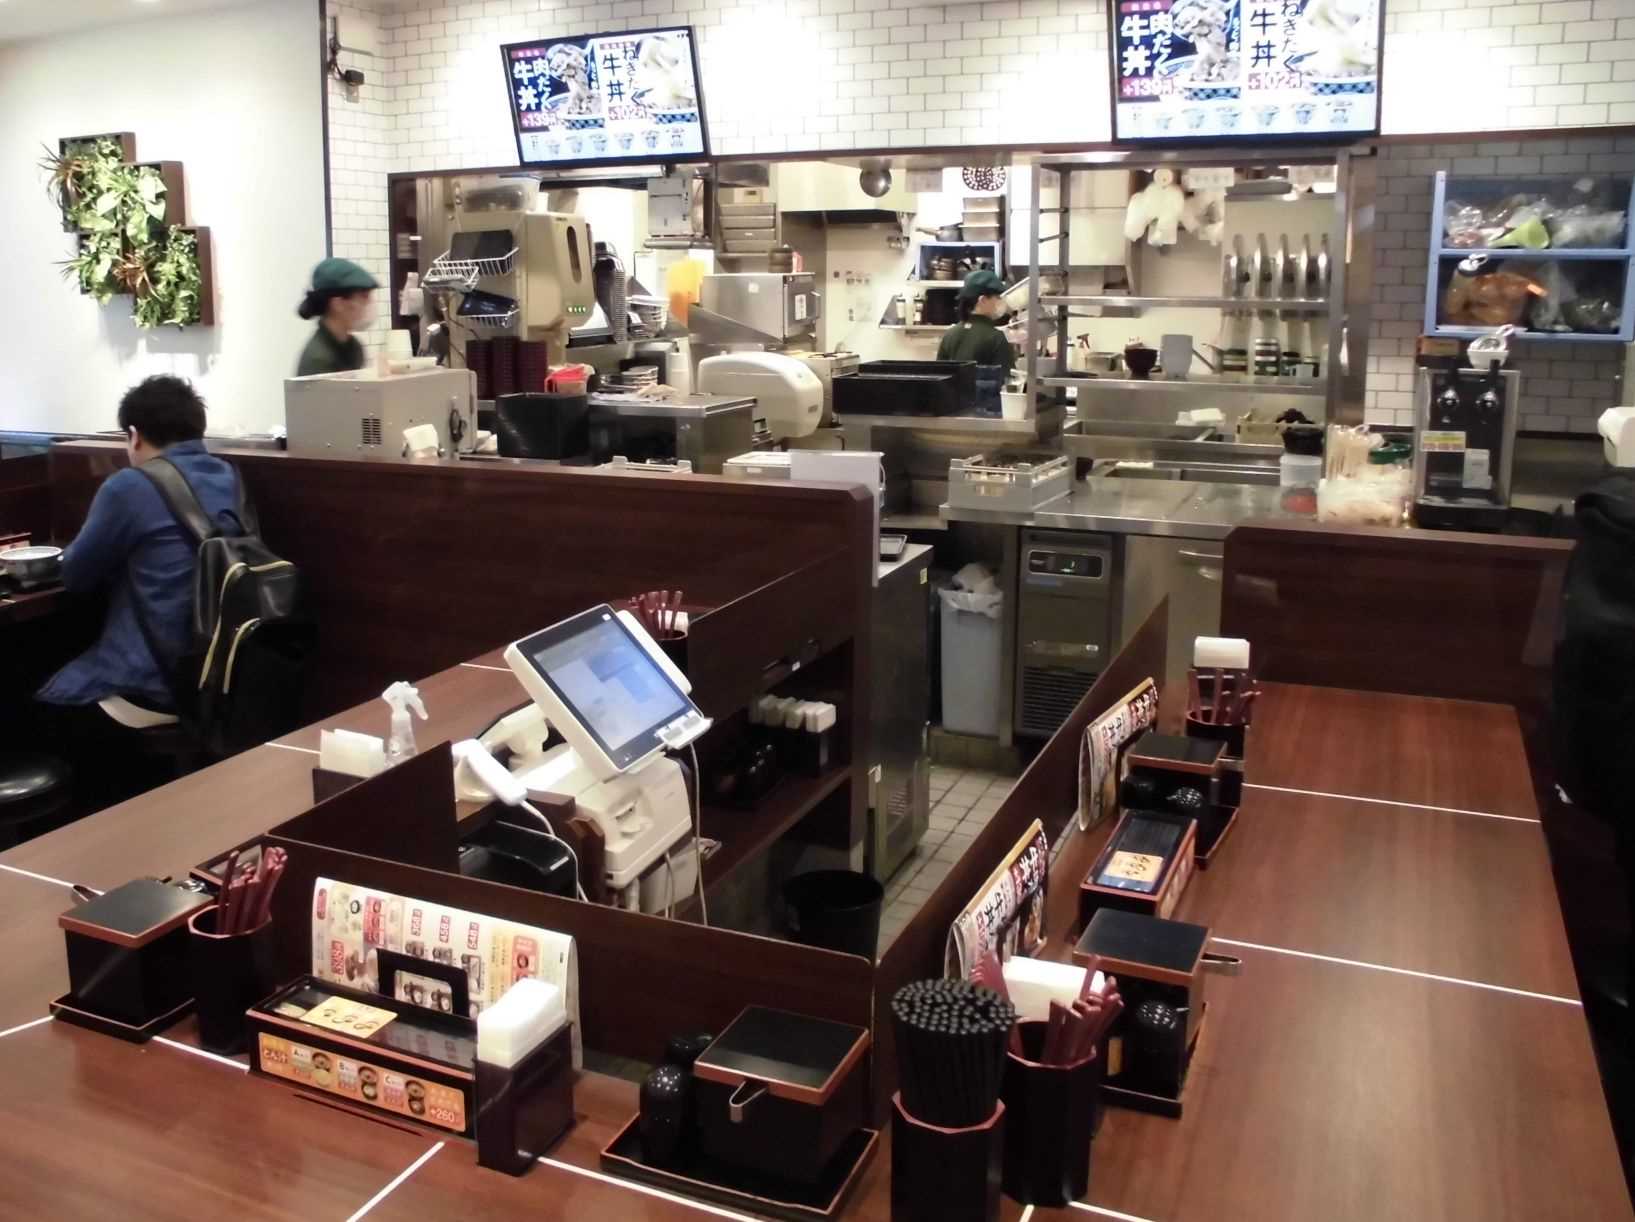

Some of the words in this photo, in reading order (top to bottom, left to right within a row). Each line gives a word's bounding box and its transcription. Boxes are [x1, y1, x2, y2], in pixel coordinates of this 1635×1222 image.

[1120, 14, 1152, 77] 牛丼
[1250, 8, 1278, 69] 牛丼
[513, 60, 539, 111] 牛丼
[603, 53, 625, 102] 牛丼
